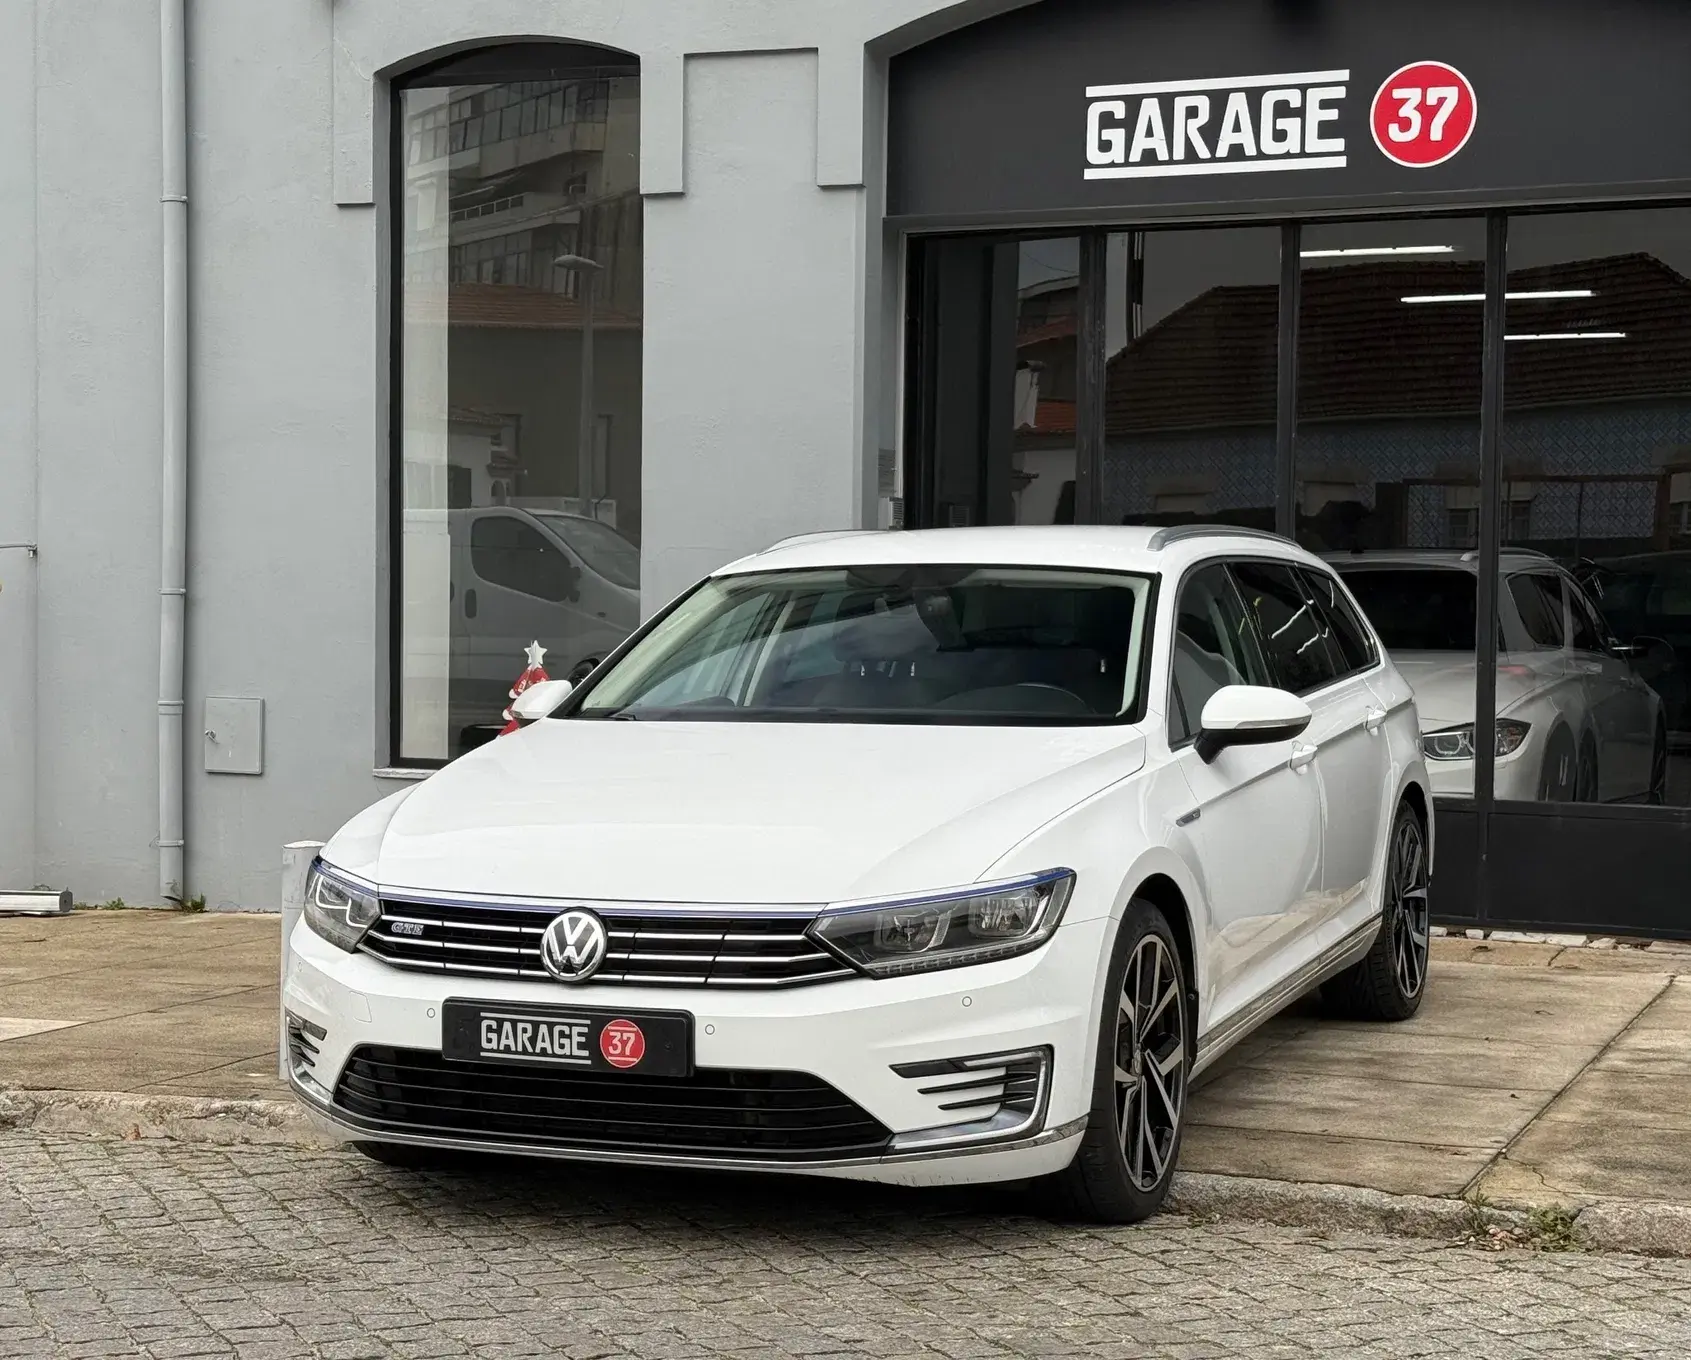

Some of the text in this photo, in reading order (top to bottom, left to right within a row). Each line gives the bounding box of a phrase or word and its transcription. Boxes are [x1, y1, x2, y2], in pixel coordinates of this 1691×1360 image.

[1086, 85, 1459, 165] GARAGE 37
[391, 921, 424, 936] GTE
[542, 911, 604, 979] VW
[480, 1019, 636, 1057] GARAGE 37
